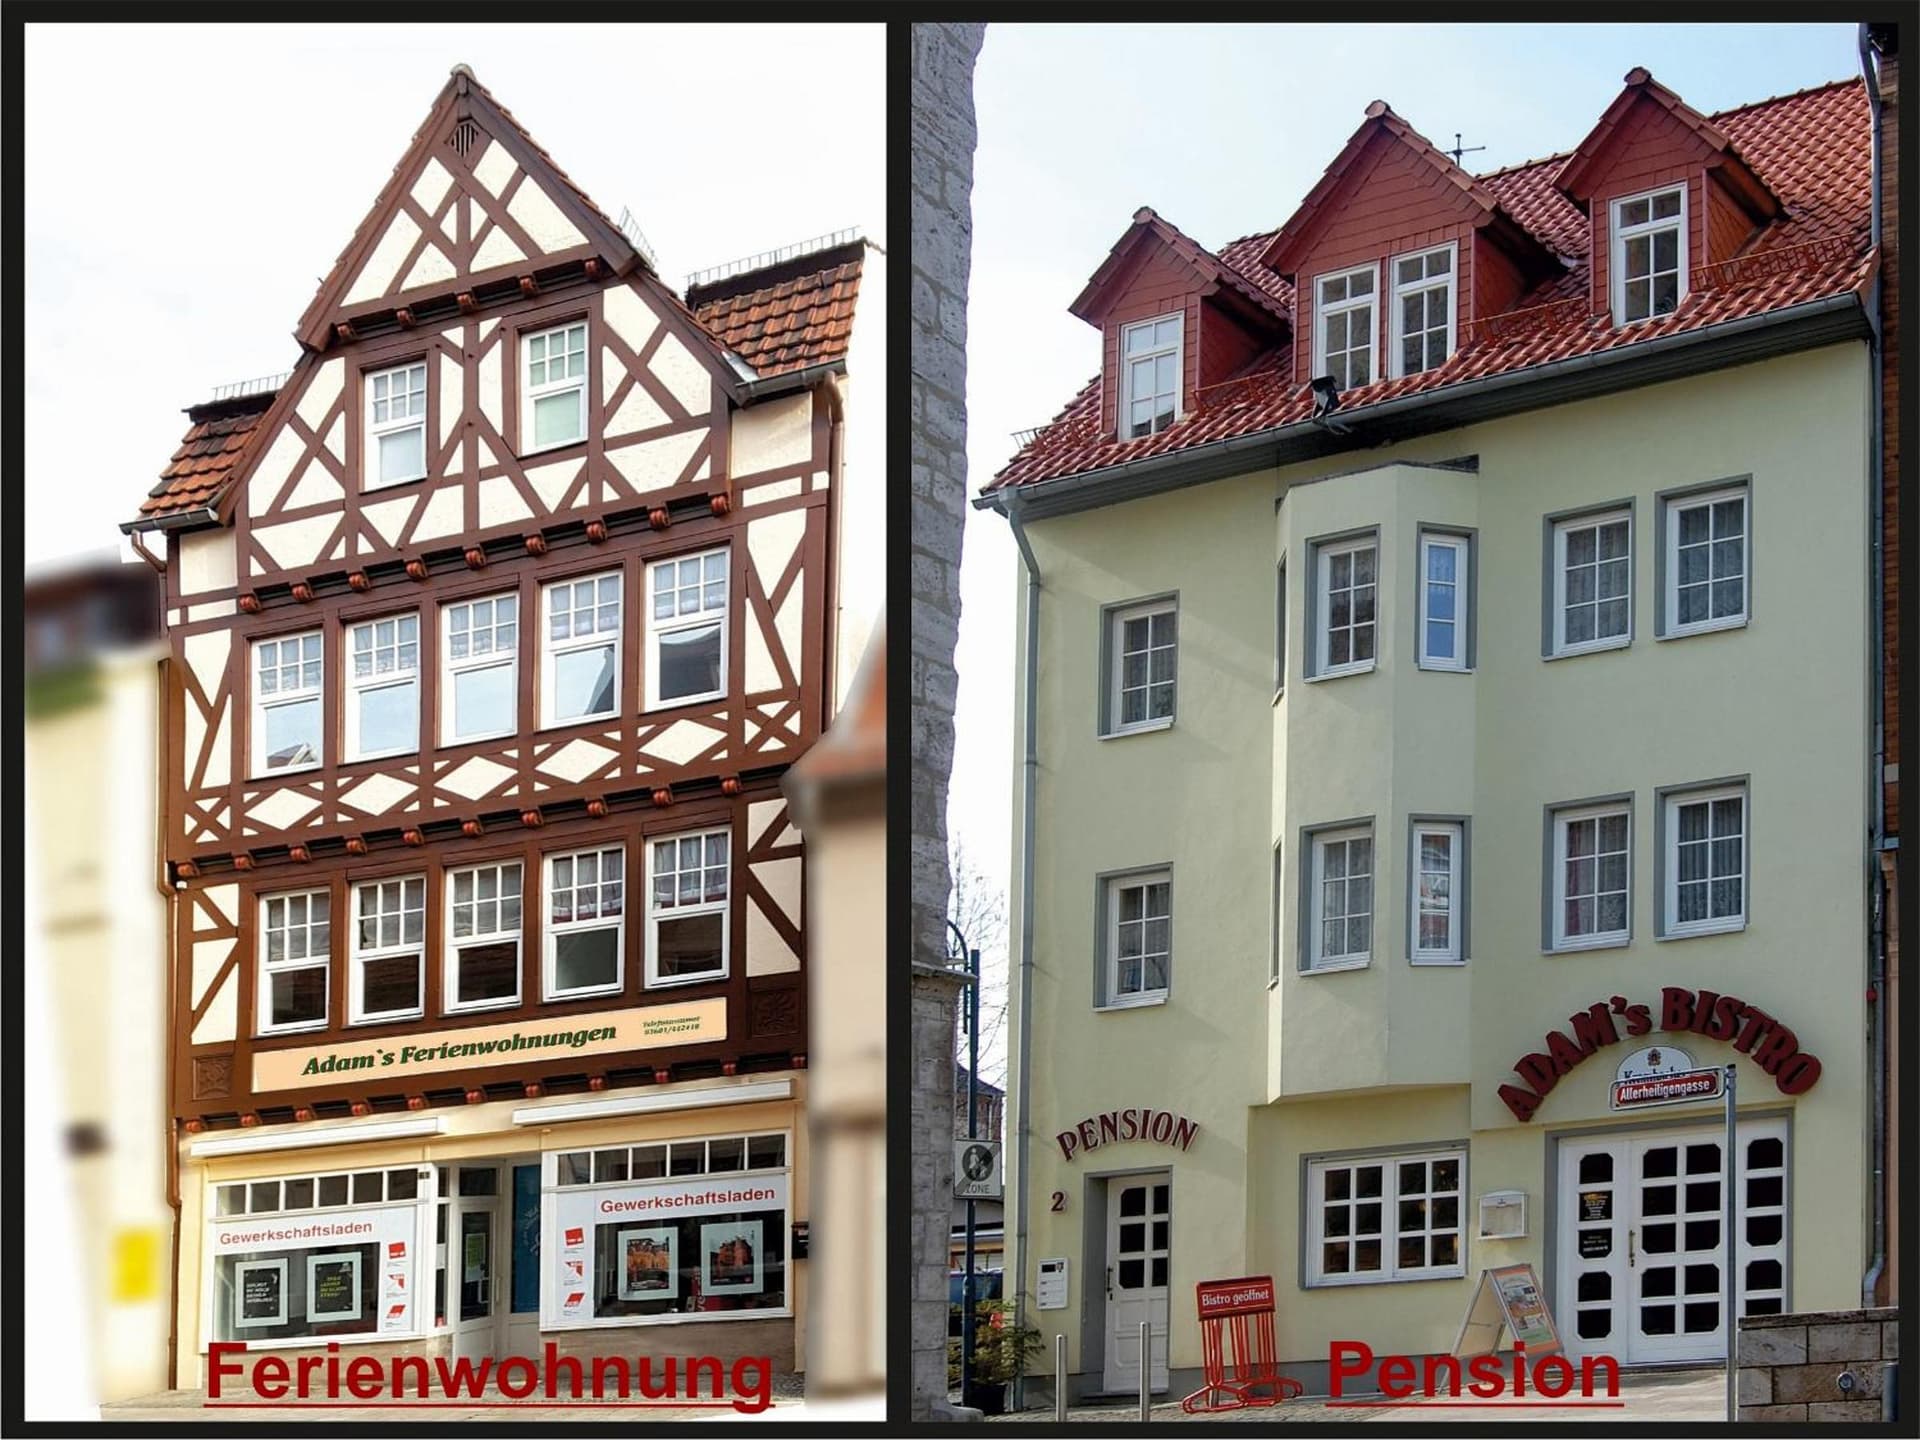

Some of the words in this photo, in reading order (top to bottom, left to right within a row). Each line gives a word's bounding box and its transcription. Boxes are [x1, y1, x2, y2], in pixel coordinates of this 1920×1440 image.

[400, 1026, 617, 1064] Ferienwohnungen
[1497, 995, 1652, 1122] ADAM's
[1660, 986, 1822, 1095] BISTRO
[1620, 1079, 1711, 1101] Allerheiligengasse
[1056, 1109, 1199, 1162] PENSION
[601, 1188, 776, 1213] Gewerkschaftsladen
[966, 1183, 991, 1195] ZONE
[1051, 1191, 1065, 1212] 2
[220, 1222, 373, 1245] Gewerkschaftsladen
[1202, 1294, 1231, 1306] Bistro
[1232, 1289, 1269, 1305] geöffnet
